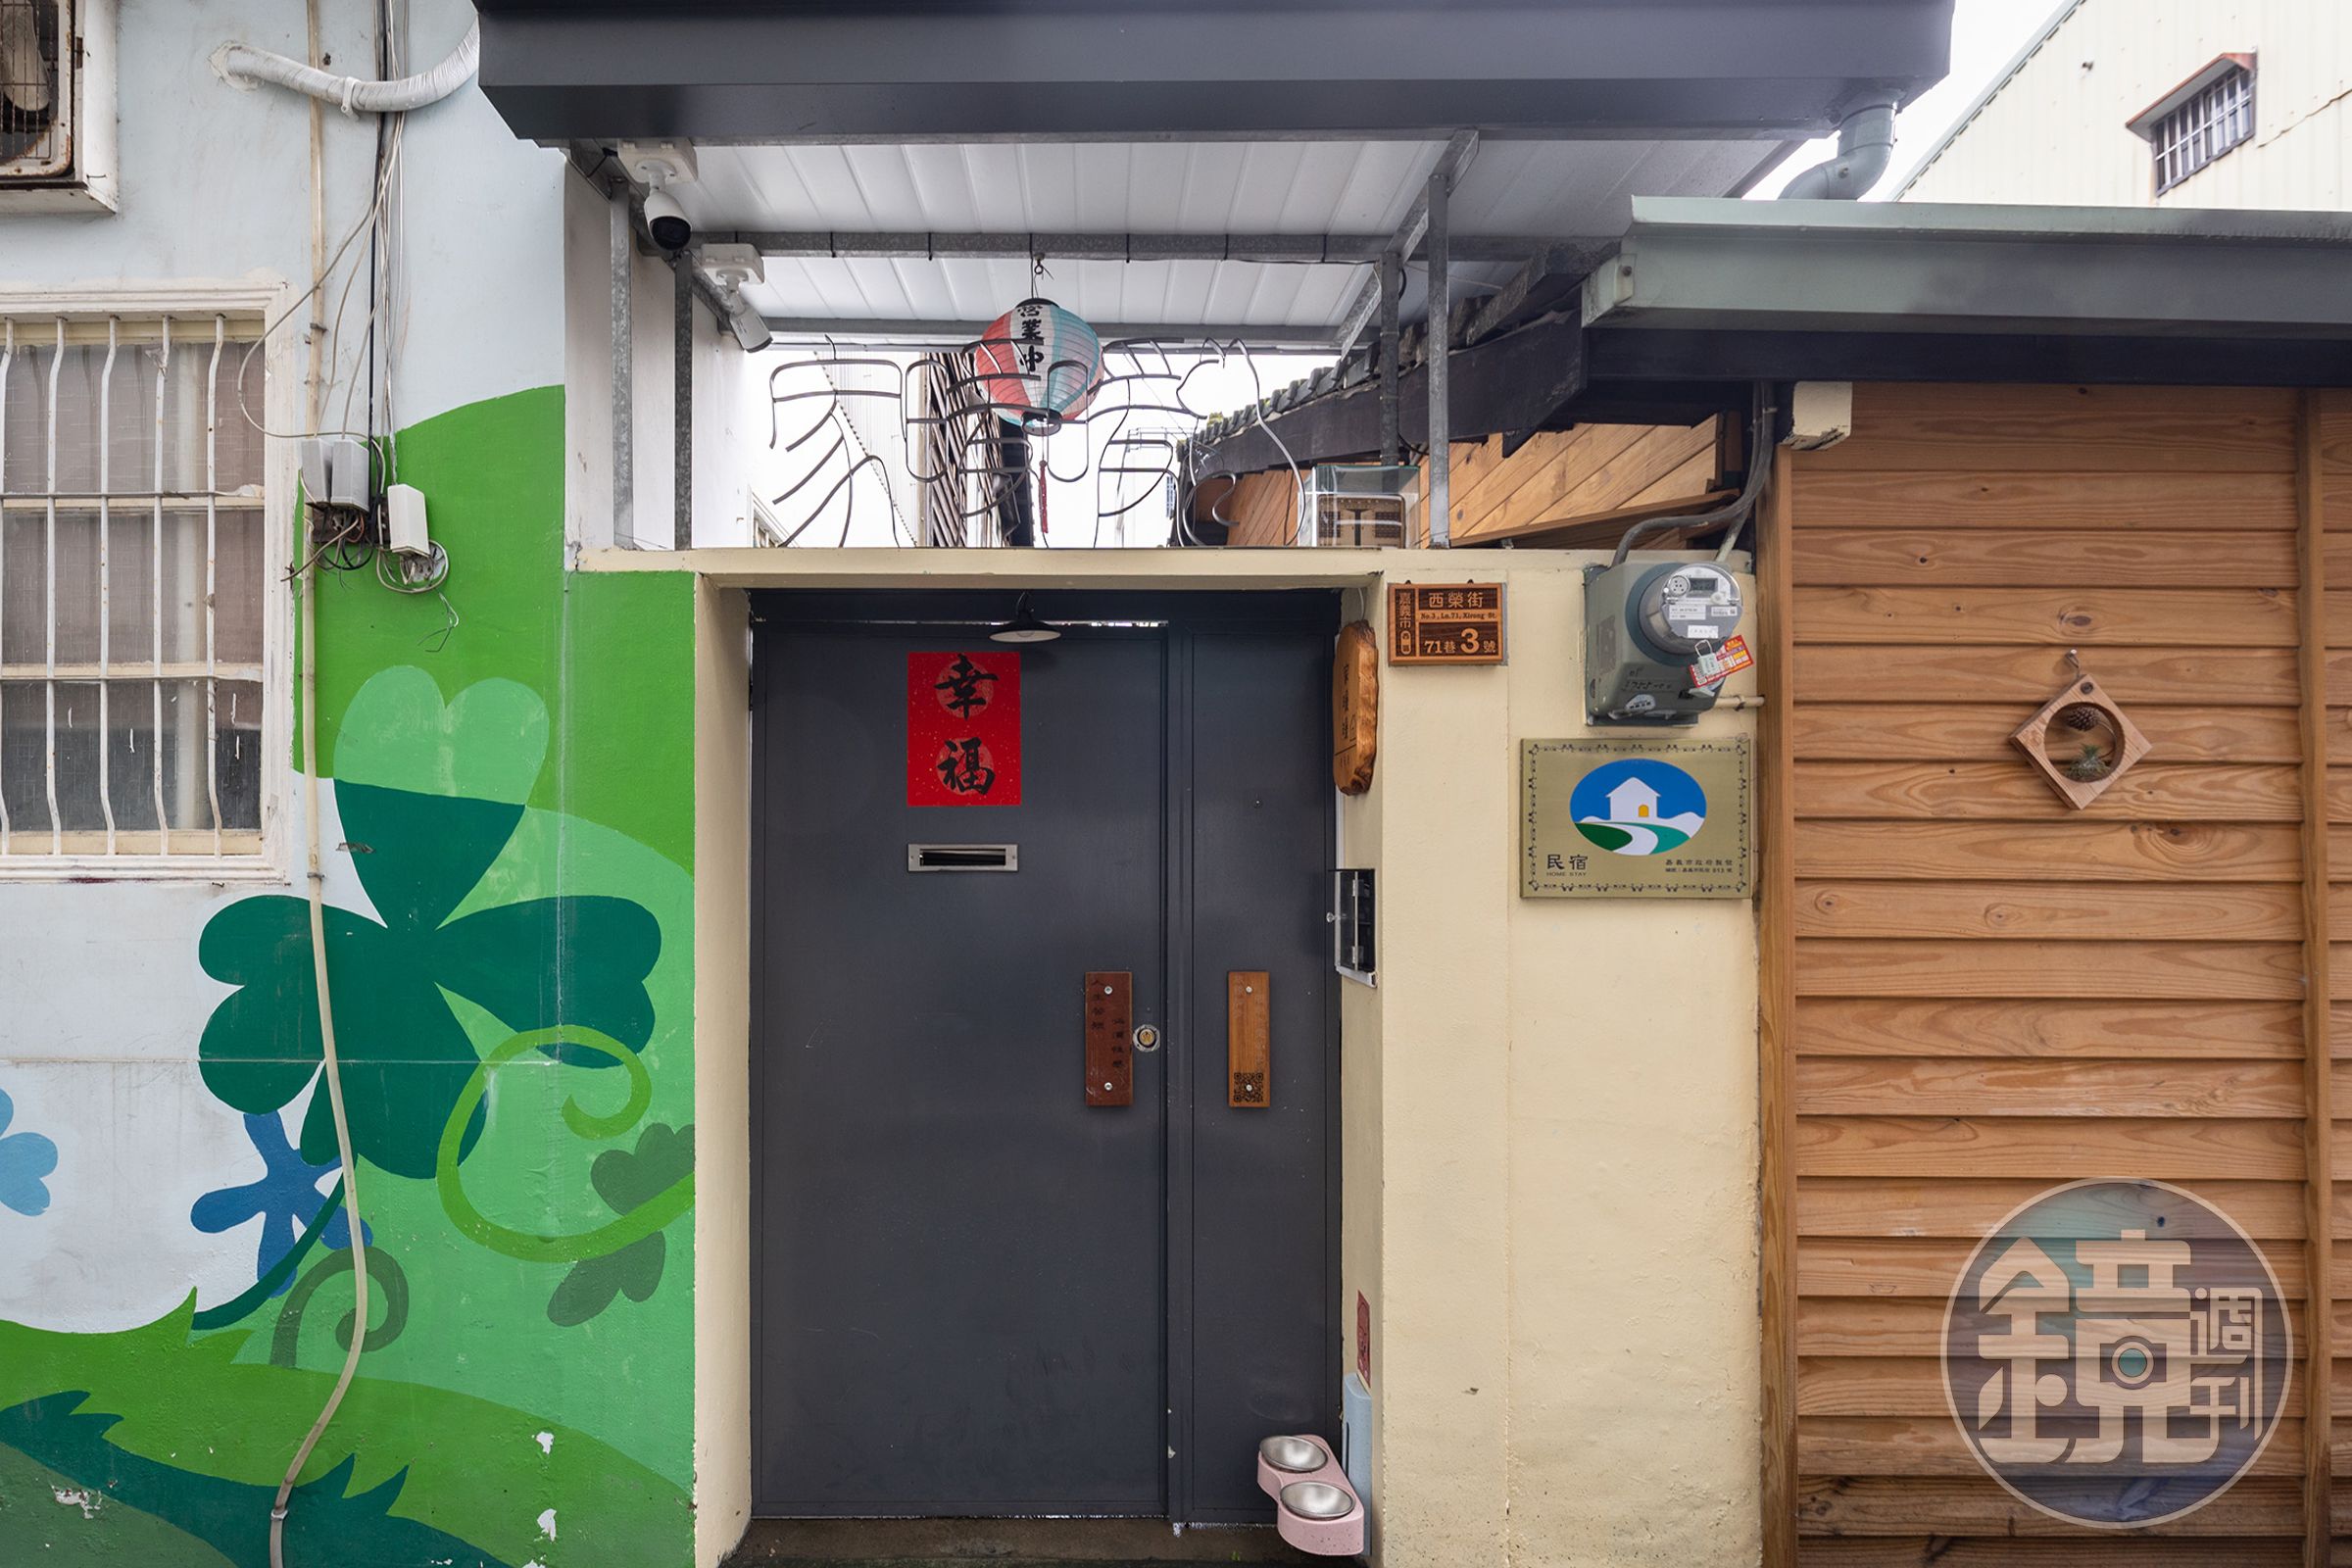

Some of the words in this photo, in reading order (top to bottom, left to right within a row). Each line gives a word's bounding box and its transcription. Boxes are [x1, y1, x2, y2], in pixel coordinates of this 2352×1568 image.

[1429, 591, 1484, 609] 西榮街
[934, 654, 999, 796] 幸福
[1546, 854, 1588, 870] 民宿
